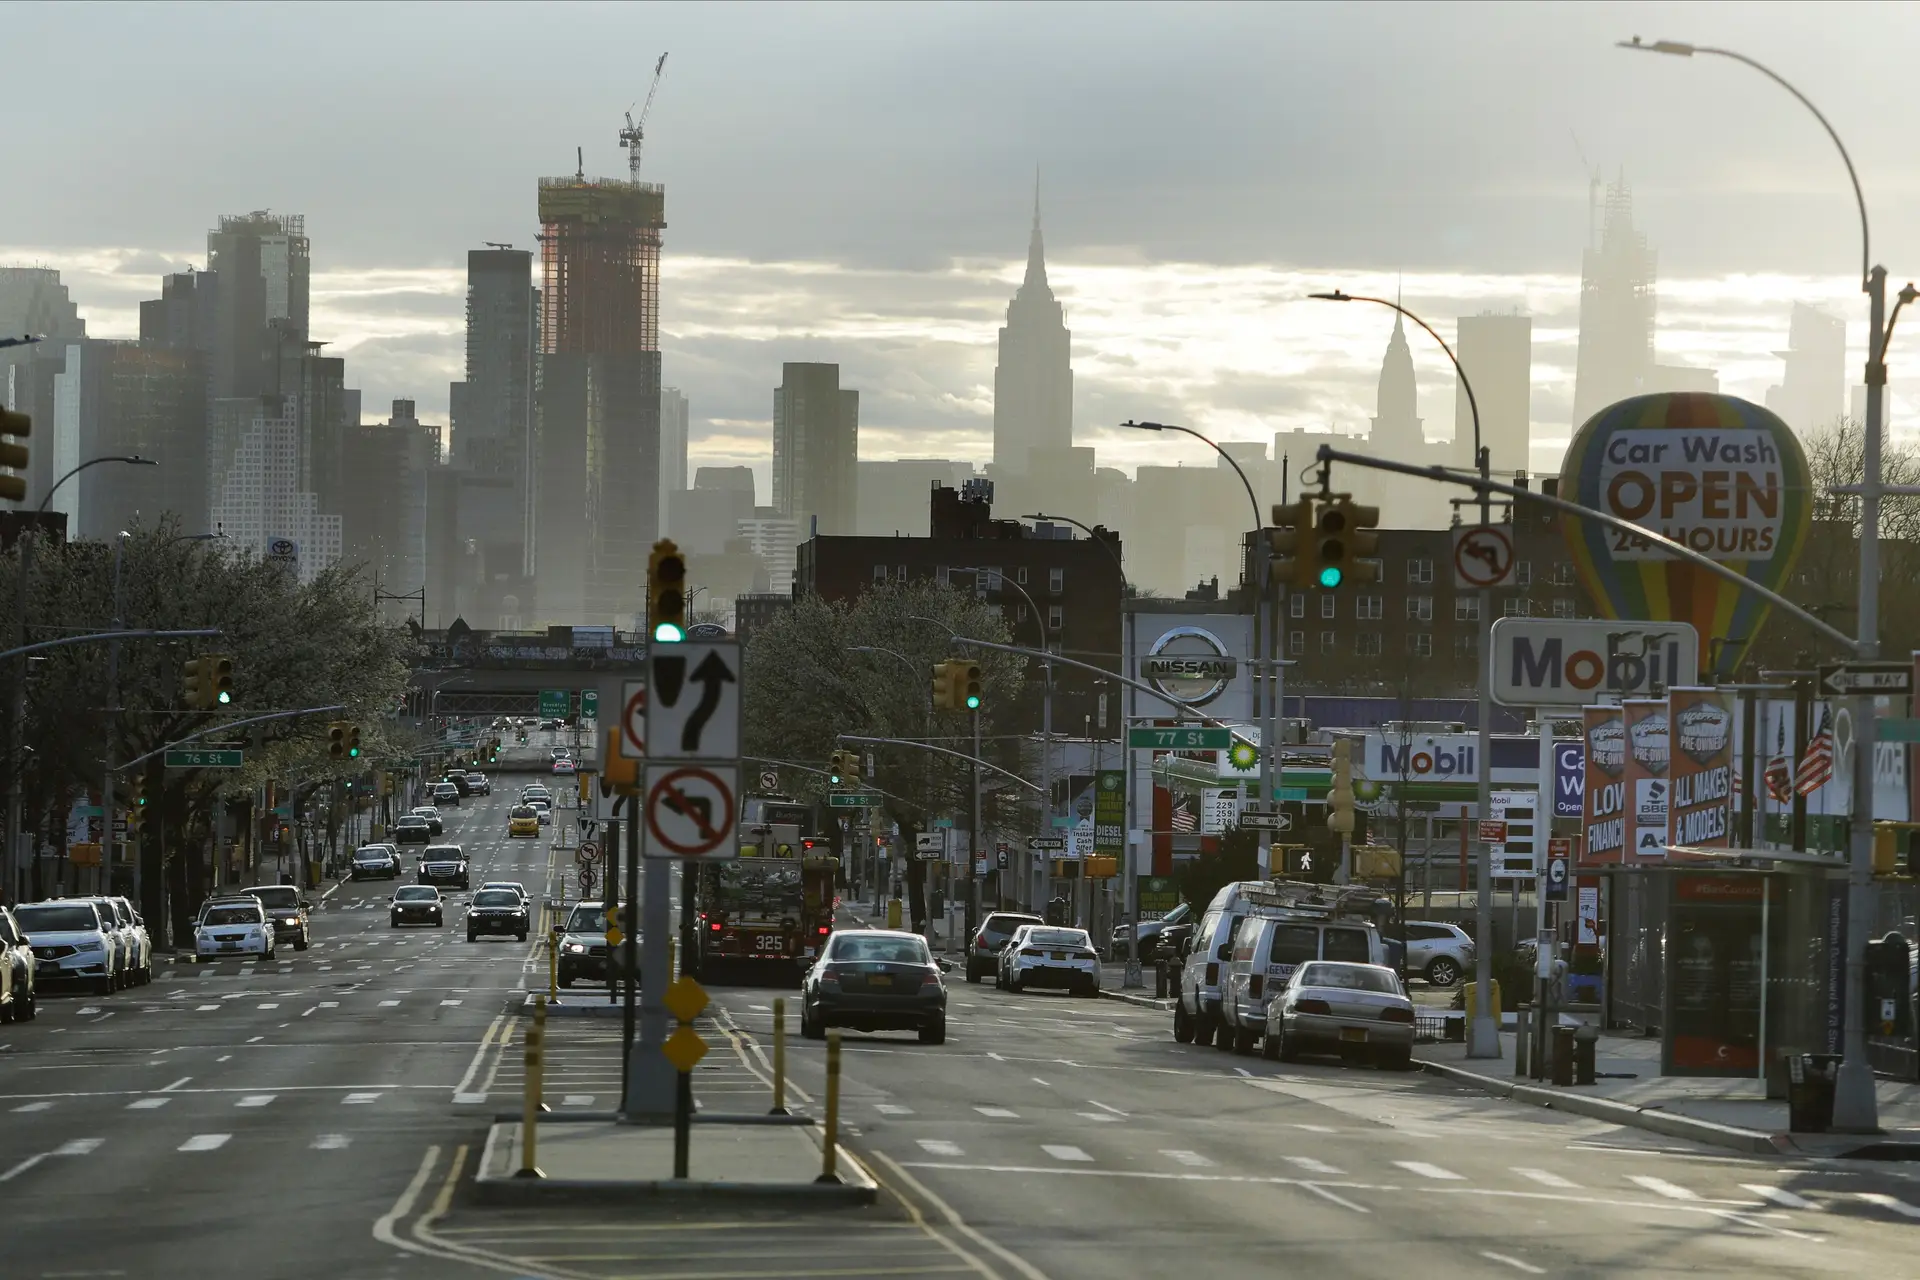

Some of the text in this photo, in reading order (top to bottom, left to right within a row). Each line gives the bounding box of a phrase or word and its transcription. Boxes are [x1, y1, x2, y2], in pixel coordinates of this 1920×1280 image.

[1608, 435, 1776, 465] Car Wash
[1607, 470, 1778, 521] OPEN
[1611, 525, 1774, 552] 24 HOURS
[1150, 661, 1228, 674] NISSAN
[1512, 635, 1679, 691] Mobil
[1833, 672, 1903, 687] ONE WAY
[1155, 732, 1205, 745] 77 St
[185, 754, 223, 764] 76 St
[1381, 744, 1474, 774] Mobil
[1560, 749, 1585, 770] Ca
[1674, 765, 1728, 809] ALL MAKES
[843, 796, 869, 805] 75 St
[1216, 801, 1233, 809] 229
[1557, 801, 1583, 813] Open
[1216, 809, 1233, 817] 259
[1243, 816, 1284, 825] ONE WAY
[1675, 805, 1726, 845] & MODELS
[1096, 825, 1123, 837] DIESEL
[1095, 837, 1122, 846] SOLD HERE
[755, 935, 783, 950] 325
[1827, 1003, 1839, 1011] &
